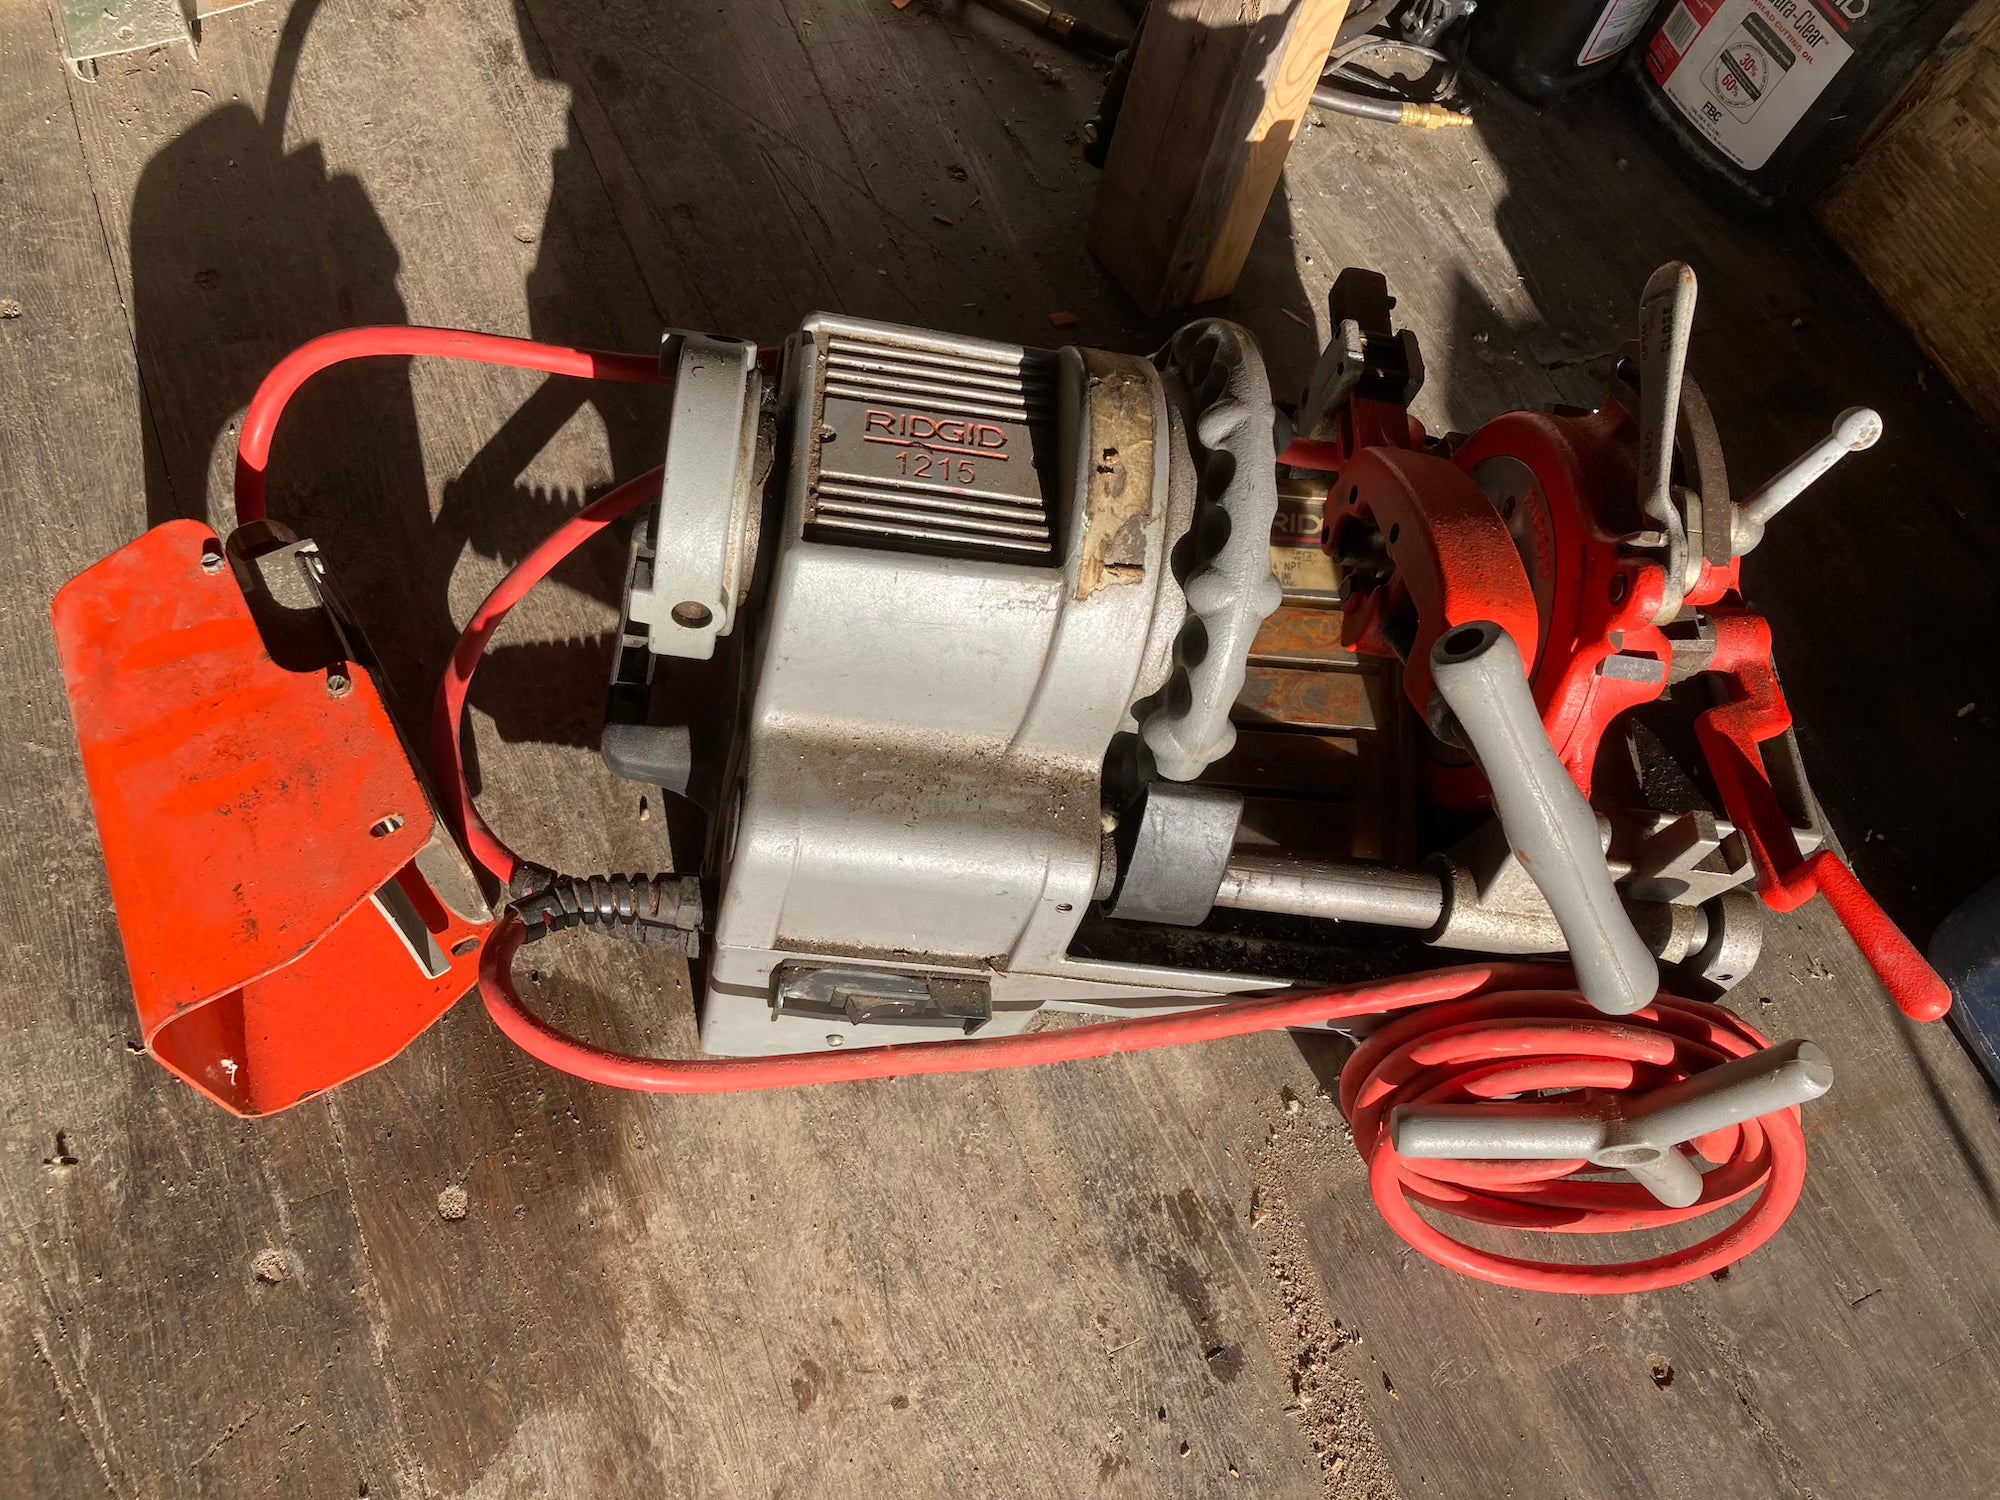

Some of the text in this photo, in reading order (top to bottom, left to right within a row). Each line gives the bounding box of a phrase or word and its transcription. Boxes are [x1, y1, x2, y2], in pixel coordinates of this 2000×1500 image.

[1753, 0, 1776, 21] HREAD
[1775, 20, 1803, 52] CUTTING
[1802, 51, 1814, 65] OIL
[1768, 0, 1825, 48] ura-Clear
[1740, 53, 1757, 77] 30%
[1722, 73, 1739, 97] 60%
[1702, 101, 1722, 122] FBC
[1660, 305, 1673, 352] CLOSE
[865, 409, 1008, 449] RIDGID
[895, 451, 975, 484] 1215
